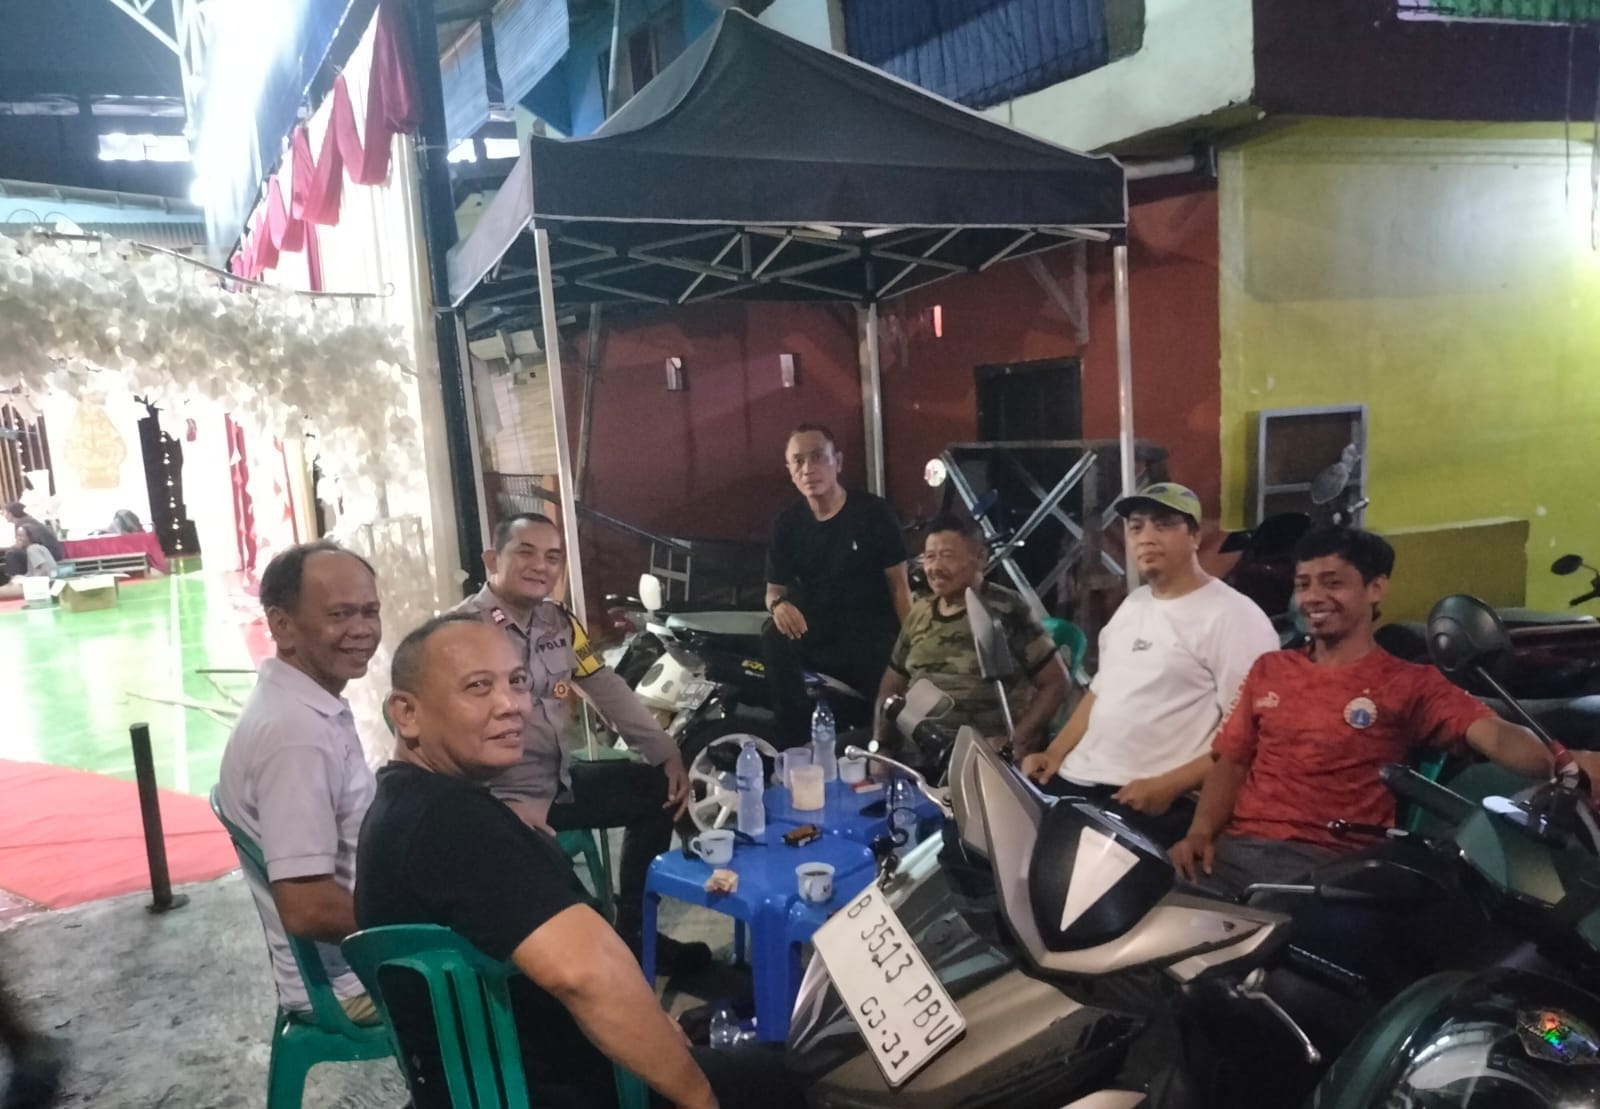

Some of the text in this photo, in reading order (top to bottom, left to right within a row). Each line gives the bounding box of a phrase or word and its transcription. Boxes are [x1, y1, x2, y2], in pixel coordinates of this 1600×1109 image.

[847, 894, 955, 1046] B 3513 PBU
